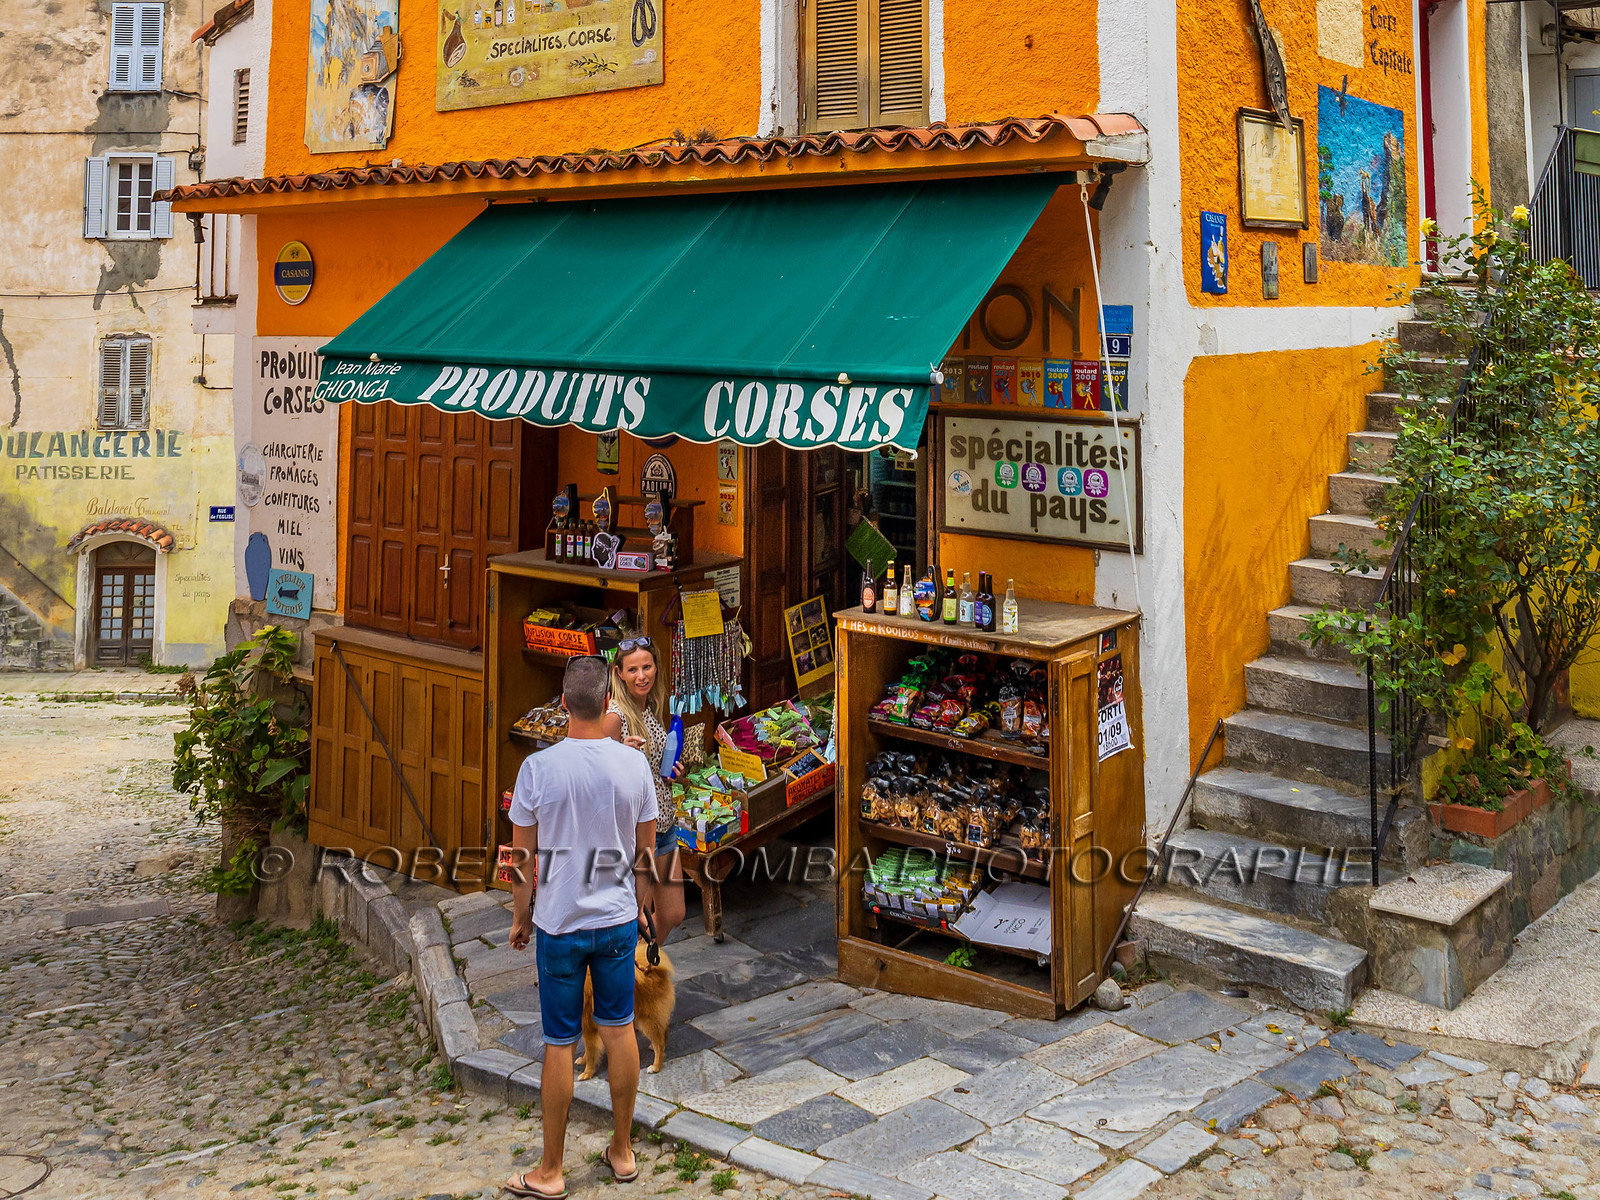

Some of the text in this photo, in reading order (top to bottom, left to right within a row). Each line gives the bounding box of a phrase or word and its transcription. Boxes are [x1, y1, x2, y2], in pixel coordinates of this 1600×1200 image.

[1205, 213, 1225, 224] CASANIS
[281, 268, 310, 278] CASANIS
[1112, 338, 1120, 354] 9
[330, 361, 402, 375] Jean Marie
[1047, 372, 1068, 380] 2009
[314, 379, 389, 399] GHIONGA
[417, 366, 914, 443] PRODUITS CORSES
[0, 429, 185, 458] ULANGERIE
[263, 442, 323, 462] CHARCUTERIE
[951, 427, 1128, 470] spécialités
[16, 464, 135, 480] PATISSERIE
[270, 466, 319, 487] FROMAGES
[265, 491, 320, 513] CONFITURES
[972, 479, 1009, 515] du
[277, 519, 302, 536] MIEL
[279, 547, 305, 571] VINS
[275, 573, 306, 592] ATELIER
[271, 596, 304, 615] POTERIE
[558, 632, 583, 644] CORSE
[1098, 721, 1122, 745] 01/09
